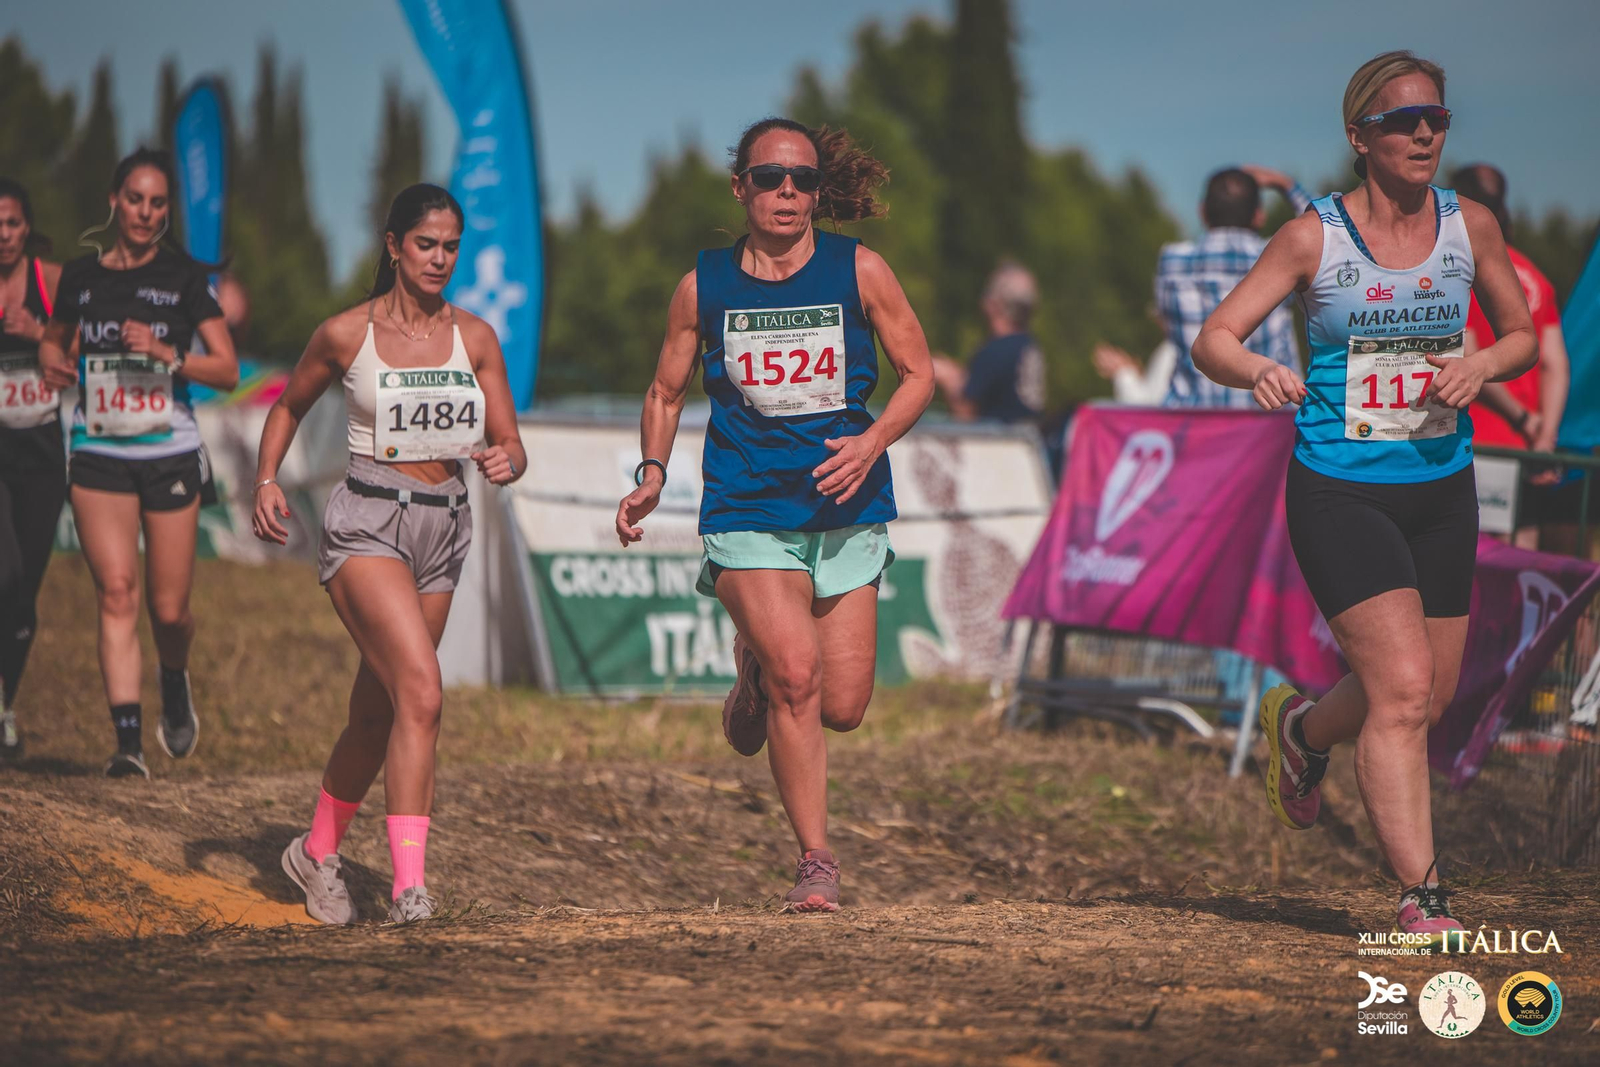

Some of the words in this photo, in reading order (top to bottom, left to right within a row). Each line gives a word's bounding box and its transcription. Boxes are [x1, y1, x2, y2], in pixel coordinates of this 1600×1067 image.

[1414, 288, 1446, 301] mayfo
[757, 313, 812, 327] ITÁLICA
[1348, 303, 1461, 328] MARACENA
[1363, 327, 1387, 335] CLUB
[1402, 323, 1450, 332] ATLETISMO
[405, 371, 456, 386] ITÁLICA
[737, 346, 838, 386] 1524
[95, 385, 167, 414] 1436
[389, 401, 478, 432] 1484
[550, 557, 656, 598] CROSS
